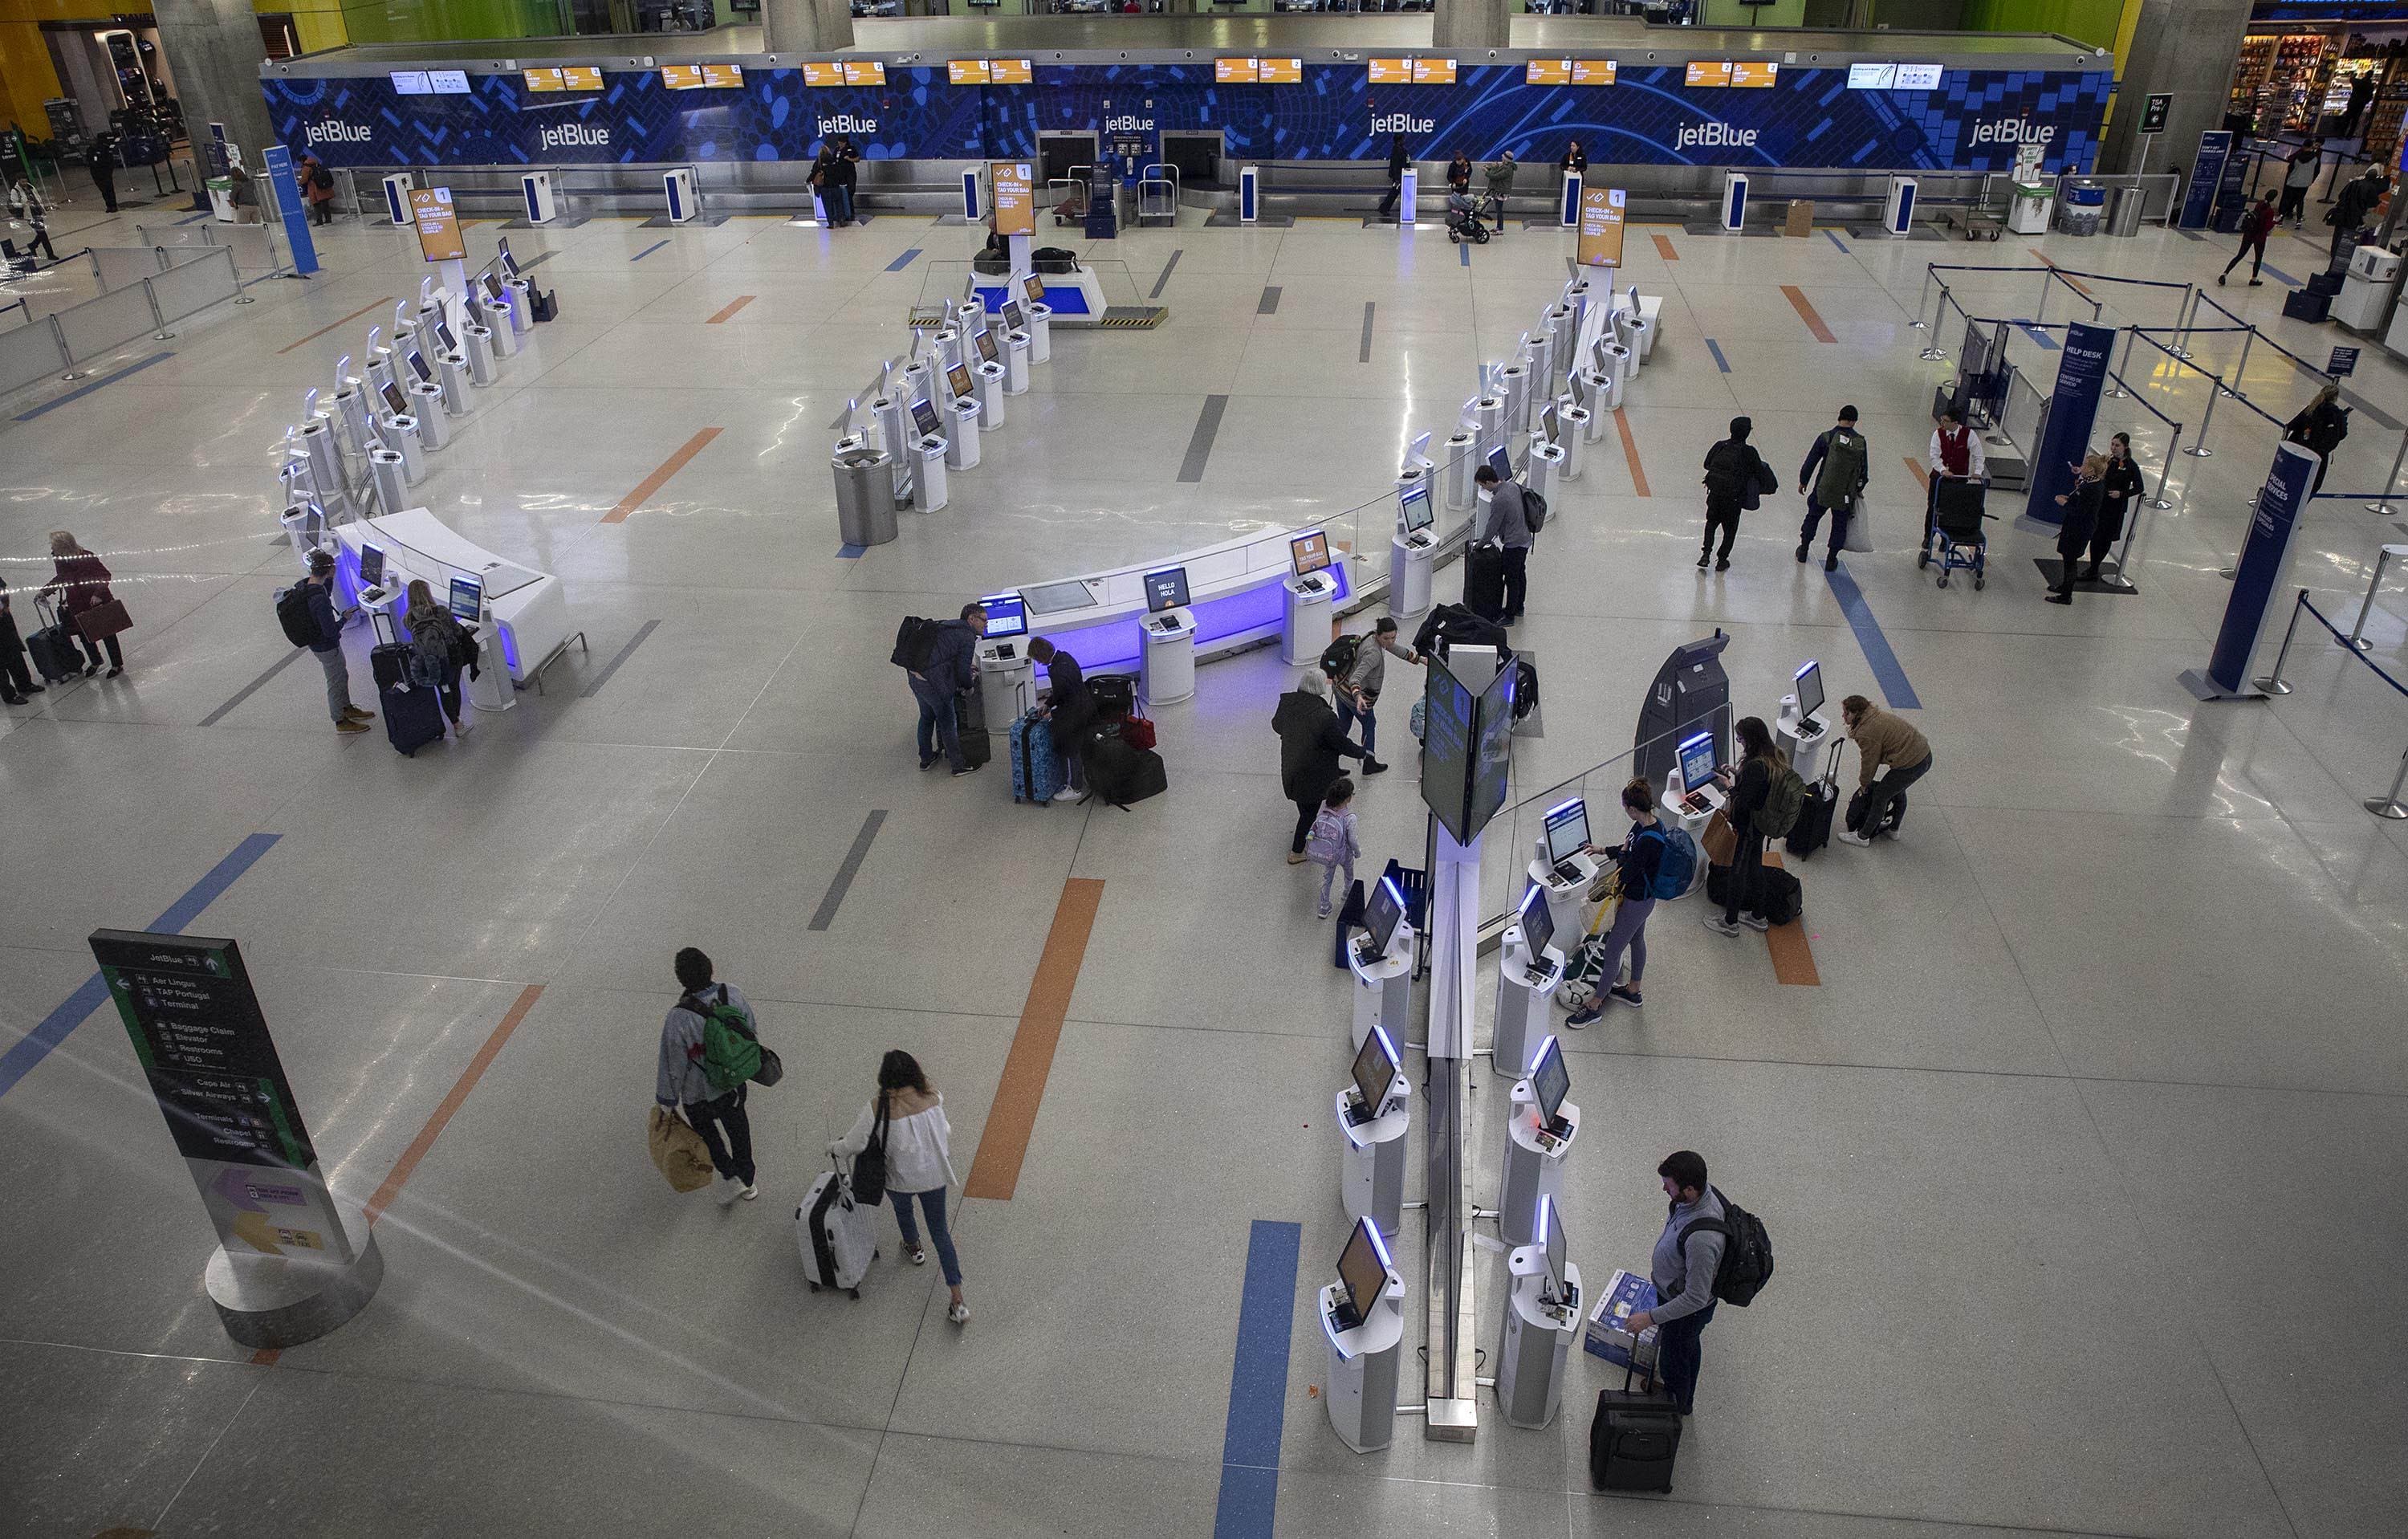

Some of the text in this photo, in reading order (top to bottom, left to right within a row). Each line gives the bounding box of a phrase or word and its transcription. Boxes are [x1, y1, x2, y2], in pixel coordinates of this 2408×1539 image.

[817, 115, 877, 138] jetBlue
[1104, 116, 1154, 134] jetBlue
[1369, 113, 1435, 136] jetBlue
[304, 120, 372, 146] jetBlue
[539, 123, 609, 150] jetBlue
[1674, 122, 1759, 151] jetBlue
[1968, 118, 2057, 148] jetBlue
[1021, 168, 1027, 176] 1
[440, 191, 445, 200] 1
[1614, 193, 1620, 203] 1
[417, 206, 440, 214] CHECK-IN
[2066, 345, 2102, 359] HELP DESK
[1308, 542, 1312, 550] 1
[1157, 581, 1175, 591] HELLO
[1160, 589, 1175, 597] HOLA
[149, 954, 183, 964] JetBlue
[153, 977, 197, 988] Aer Lingus
[156, 987, 210, 1001] TAP Portugal
[161, 1000, 200, 1010] Terminal
[170, 1022, 236, 1036] Baggage Claim
[175, 1033, 208, 1043] Elevator
[179, 1044, 223, 1056] Restrooms
[183, 1055, 203, 1063] USO
[197, 1078, 218, 1087] Cape
[180, 1088, 237, 1101] Silver Airways
[194, 1112, 234, 1123] Terminals
[223, 1127, 252, 1137] Chapel
[213, 1137, 256, 1148] Restrooms
